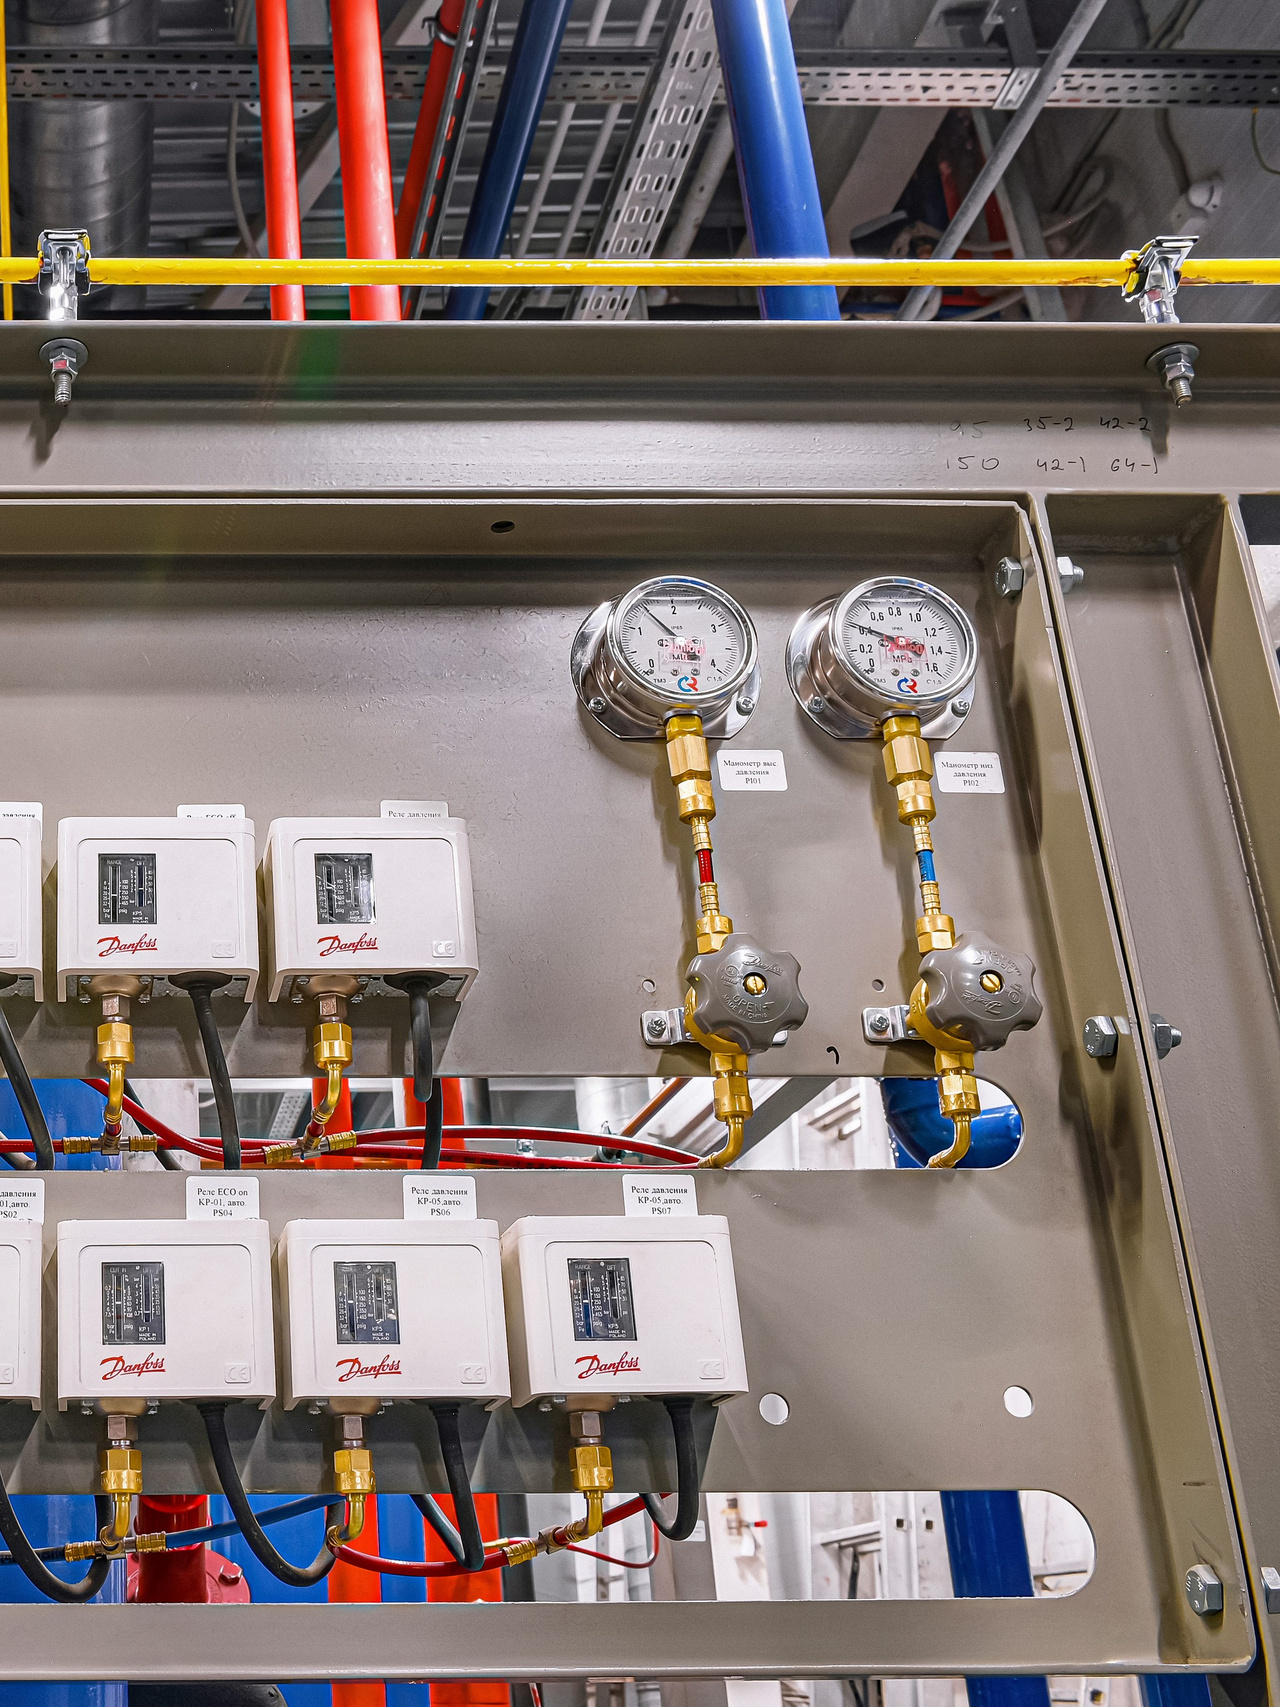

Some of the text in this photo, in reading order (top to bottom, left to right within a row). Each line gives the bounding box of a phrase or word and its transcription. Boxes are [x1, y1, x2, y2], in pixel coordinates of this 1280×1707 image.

[1023, 415, 1074, 432] 35-2
[1099, 416, 1152, 432] 42-2
[946, 455, 1158, 474] 150 42-1 64-1
[671, 606, 677, 614] 2
[888, 607, 902, 617] 0,8
[870, 612, 884, 622] 0,6
[909, 613, 922, 623] 1,0
[638, 627, 642, 635] 1
[711, 624, 717, 633] 3
[924, 628, 937, 638] 1,2
[859, 644, 873, 654] 0,2
[930, 646, 943, 656] 1,4
[649, 659, 654, 667] 0
[710, 659, 716, 667] 4
[869, 659, 875, 667] 0
[925, 663, 939, 673] 1,6
[723, 760, 761, 768] Манометр
[941, 761, 979, 769] Манометр
[97, 932, 158, 958] Danfoss
[317, 932, 379, 957] Danfoss
[197, 1187, 215, 1195] Реле
[218, 1187, 236, 1196] ECO
[411, 1186, 429, 1194] Реле
[631, 1185, 649, 1193] Реле
[430, 1208, 451, 1216] PS06
[651, 1207, 672, 1215] PS07
[100, 1352, 166, 1381] Danfoss
[335, 1354, 402, 1382] Danfoss
[575, 1351, 641, 1379] Danfoss
